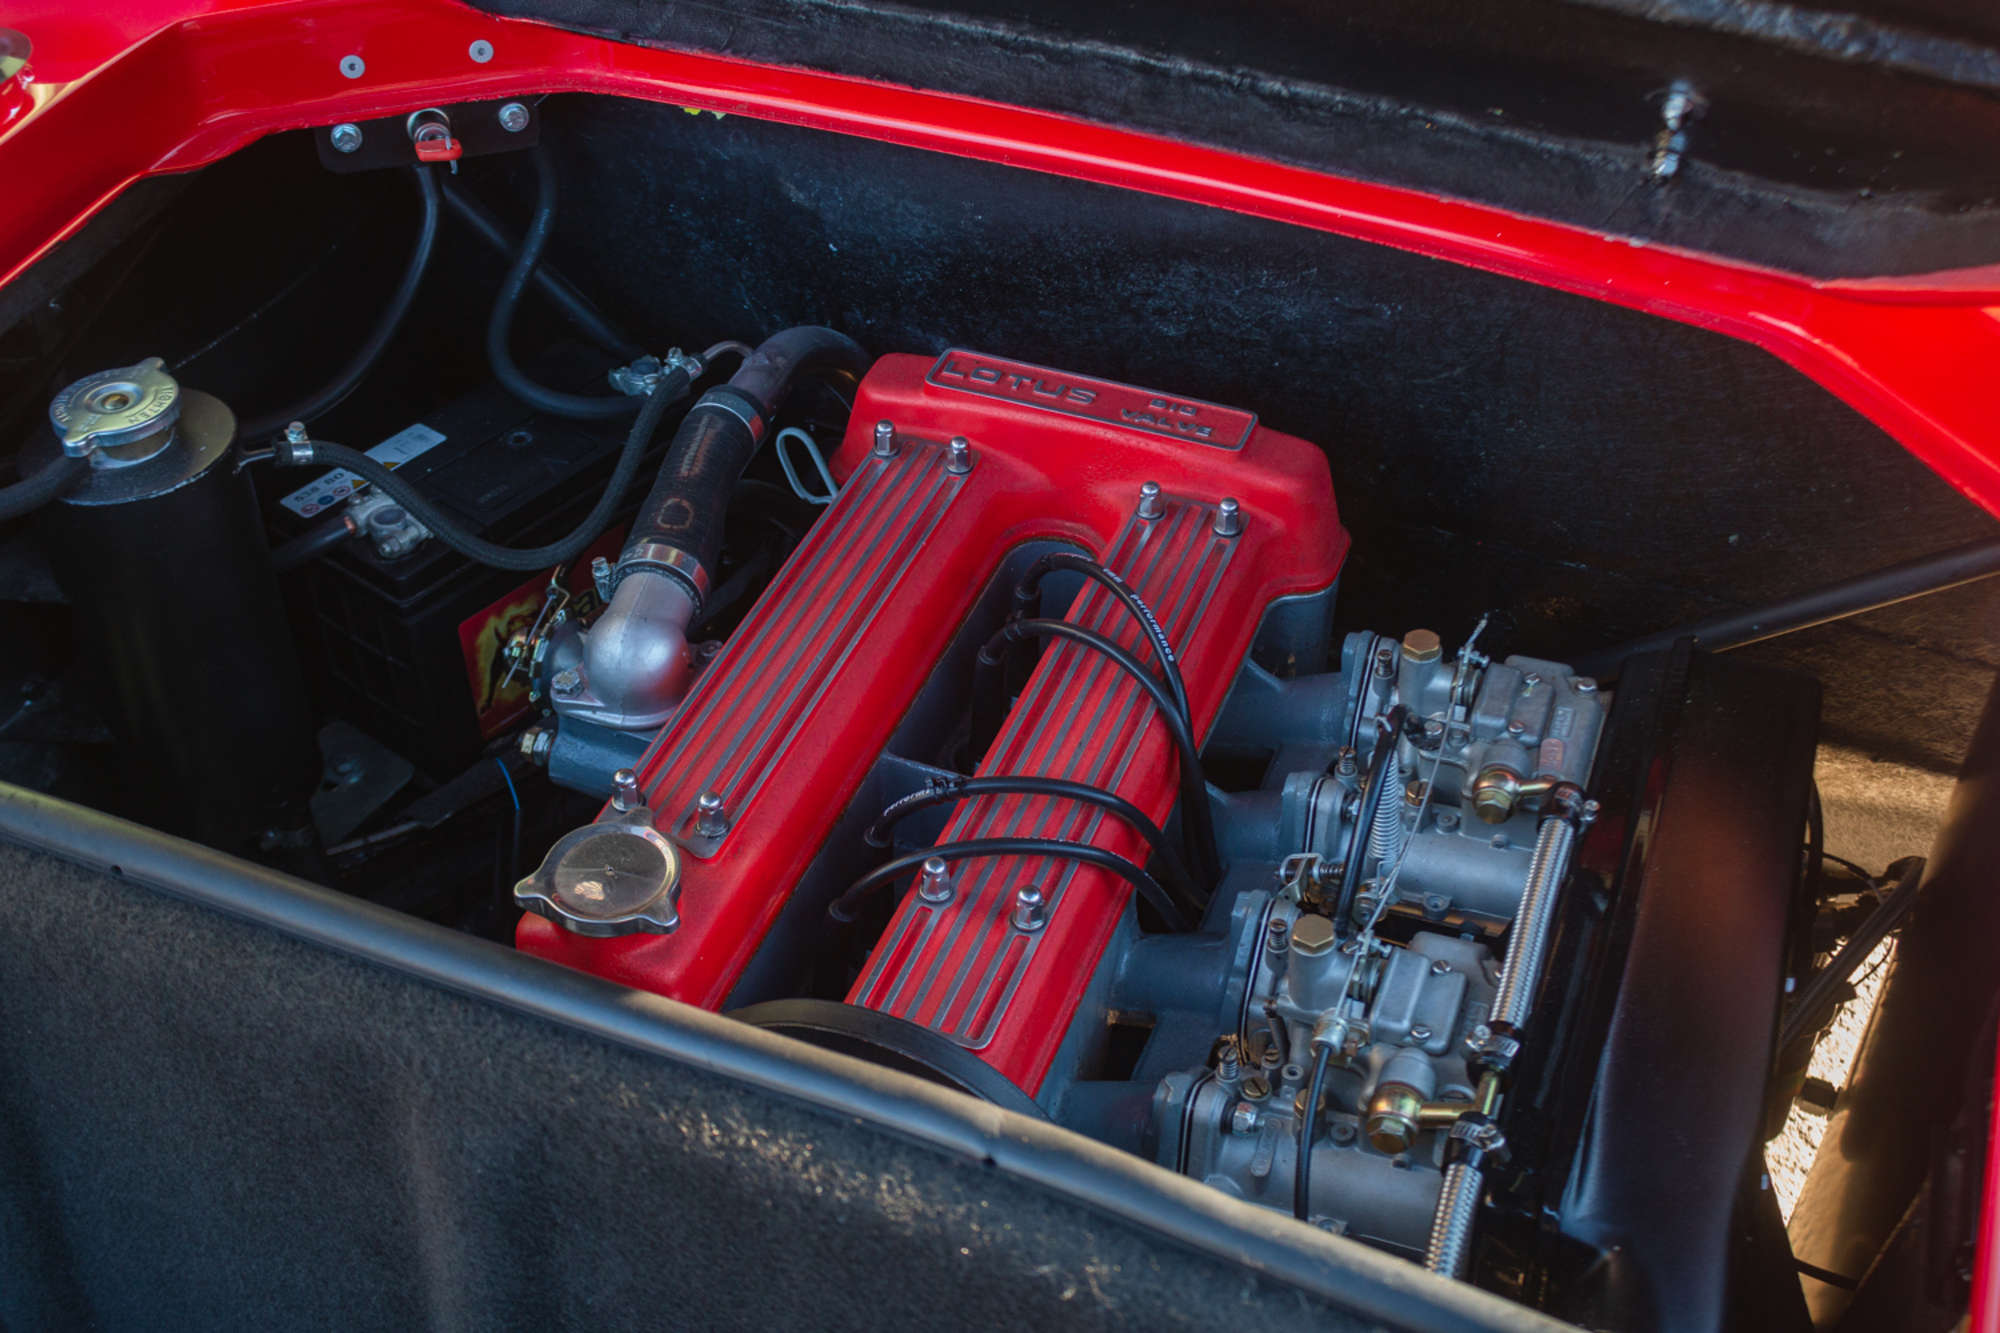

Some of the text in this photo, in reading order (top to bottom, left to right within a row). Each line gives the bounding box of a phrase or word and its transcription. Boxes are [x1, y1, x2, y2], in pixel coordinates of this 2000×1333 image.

[941, 361, 1098, 404] LOTUS
[1121, 409, 1212, 437] VALVE
[1150, 398, 1198, 416] BIG
[1130, 593, 1175, 662] performance
